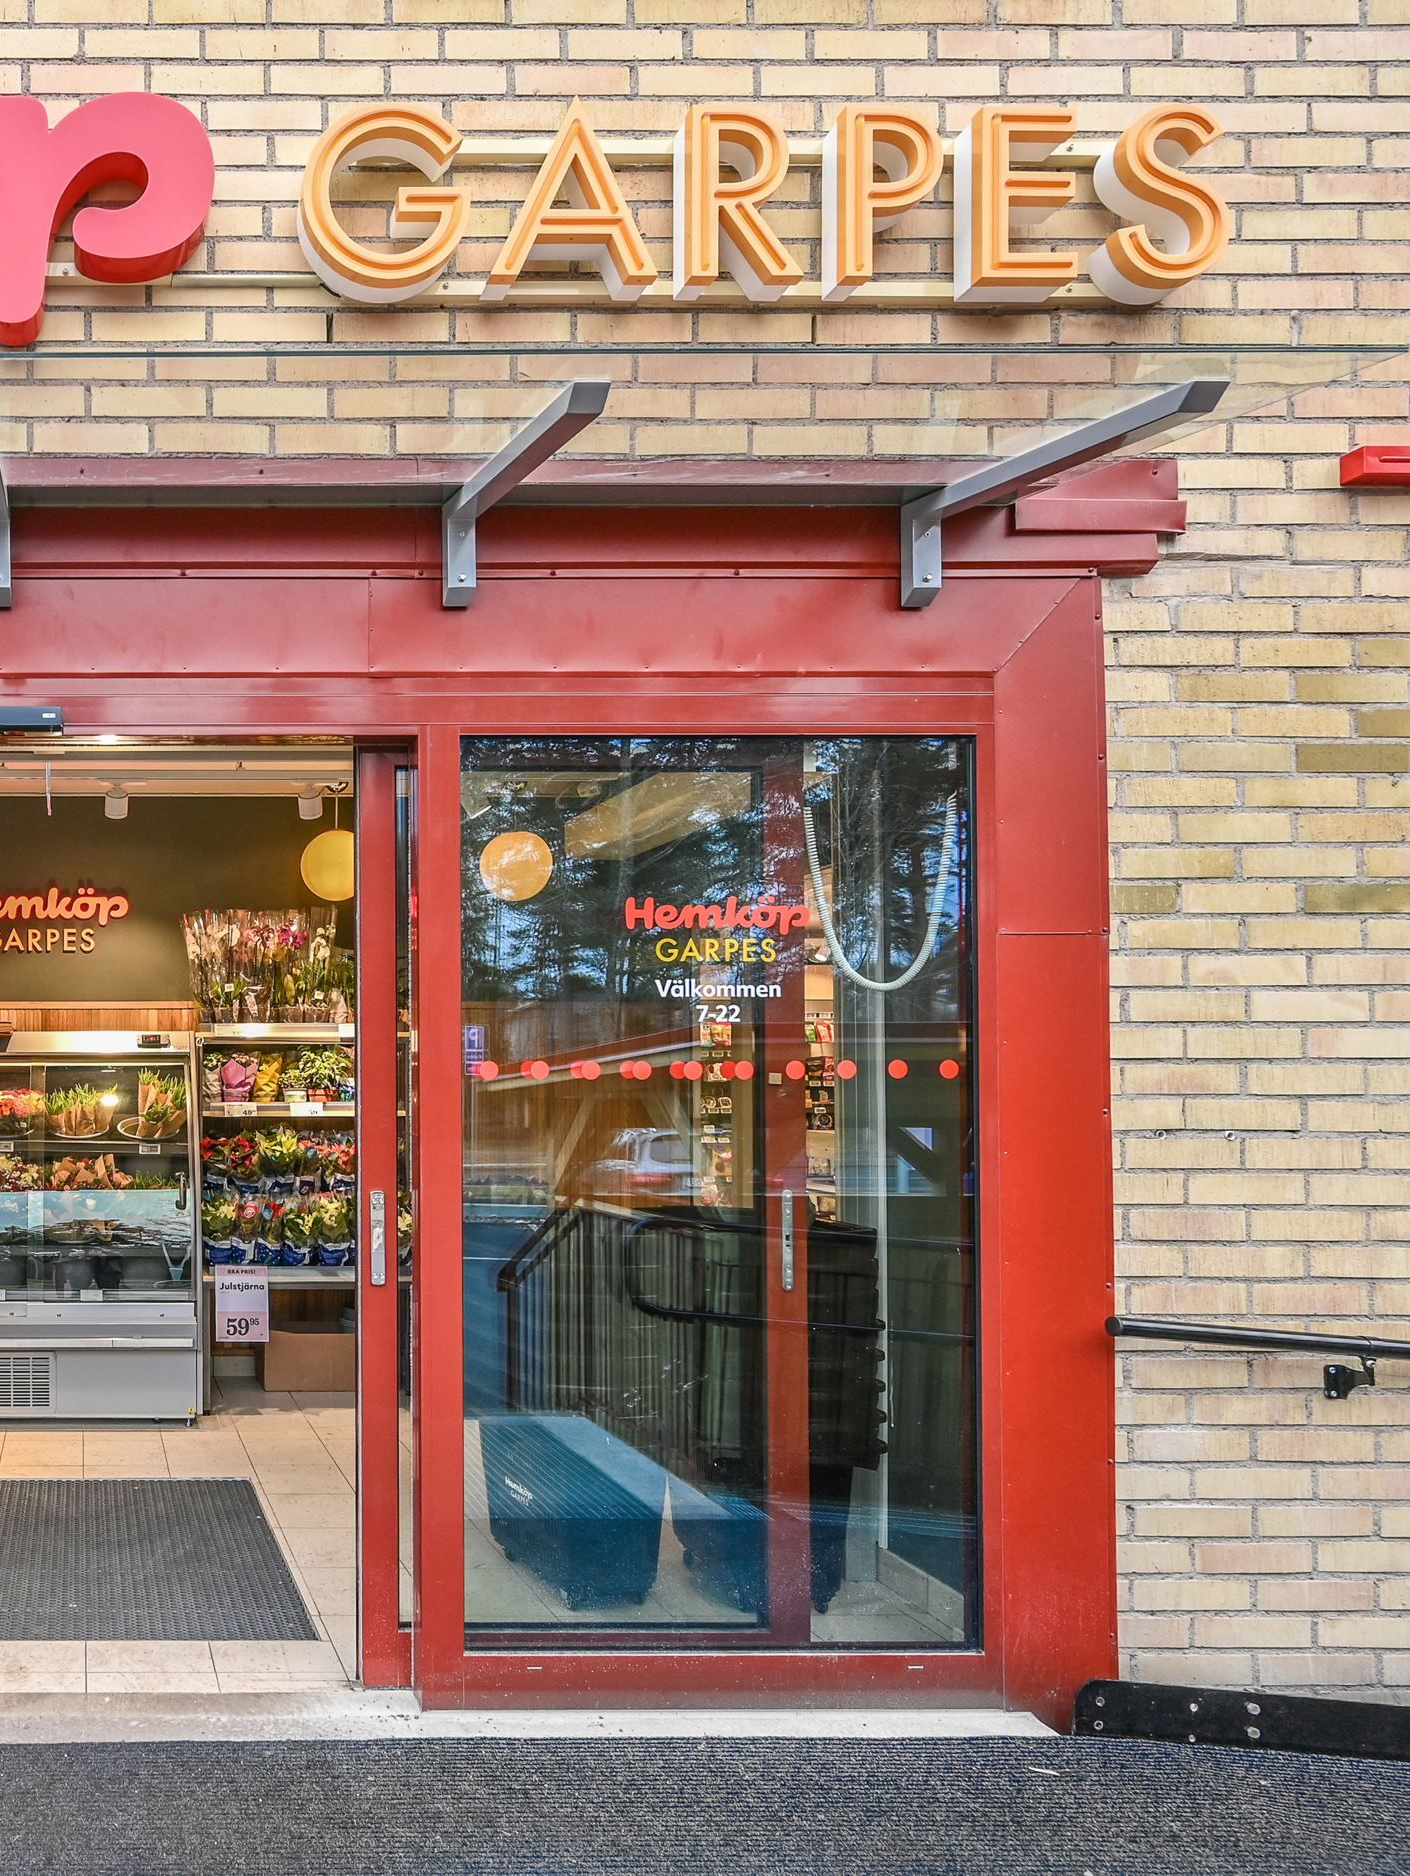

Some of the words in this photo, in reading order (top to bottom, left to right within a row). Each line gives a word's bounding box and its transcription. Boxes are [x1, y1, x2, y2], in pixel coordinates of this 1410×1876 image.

[296, 96, 1230, 305] GARPES
[624, 896, 811, 935] Hemköp
[655, 938, 777, 963] GARPES
[655, 978, 782, 999] Välkommen
[695, 1004, 741, 1023] 7-22
[219, 1282, 265, 1293] Julstjärna
[504, 1476, 533, 1500] Hemköp
